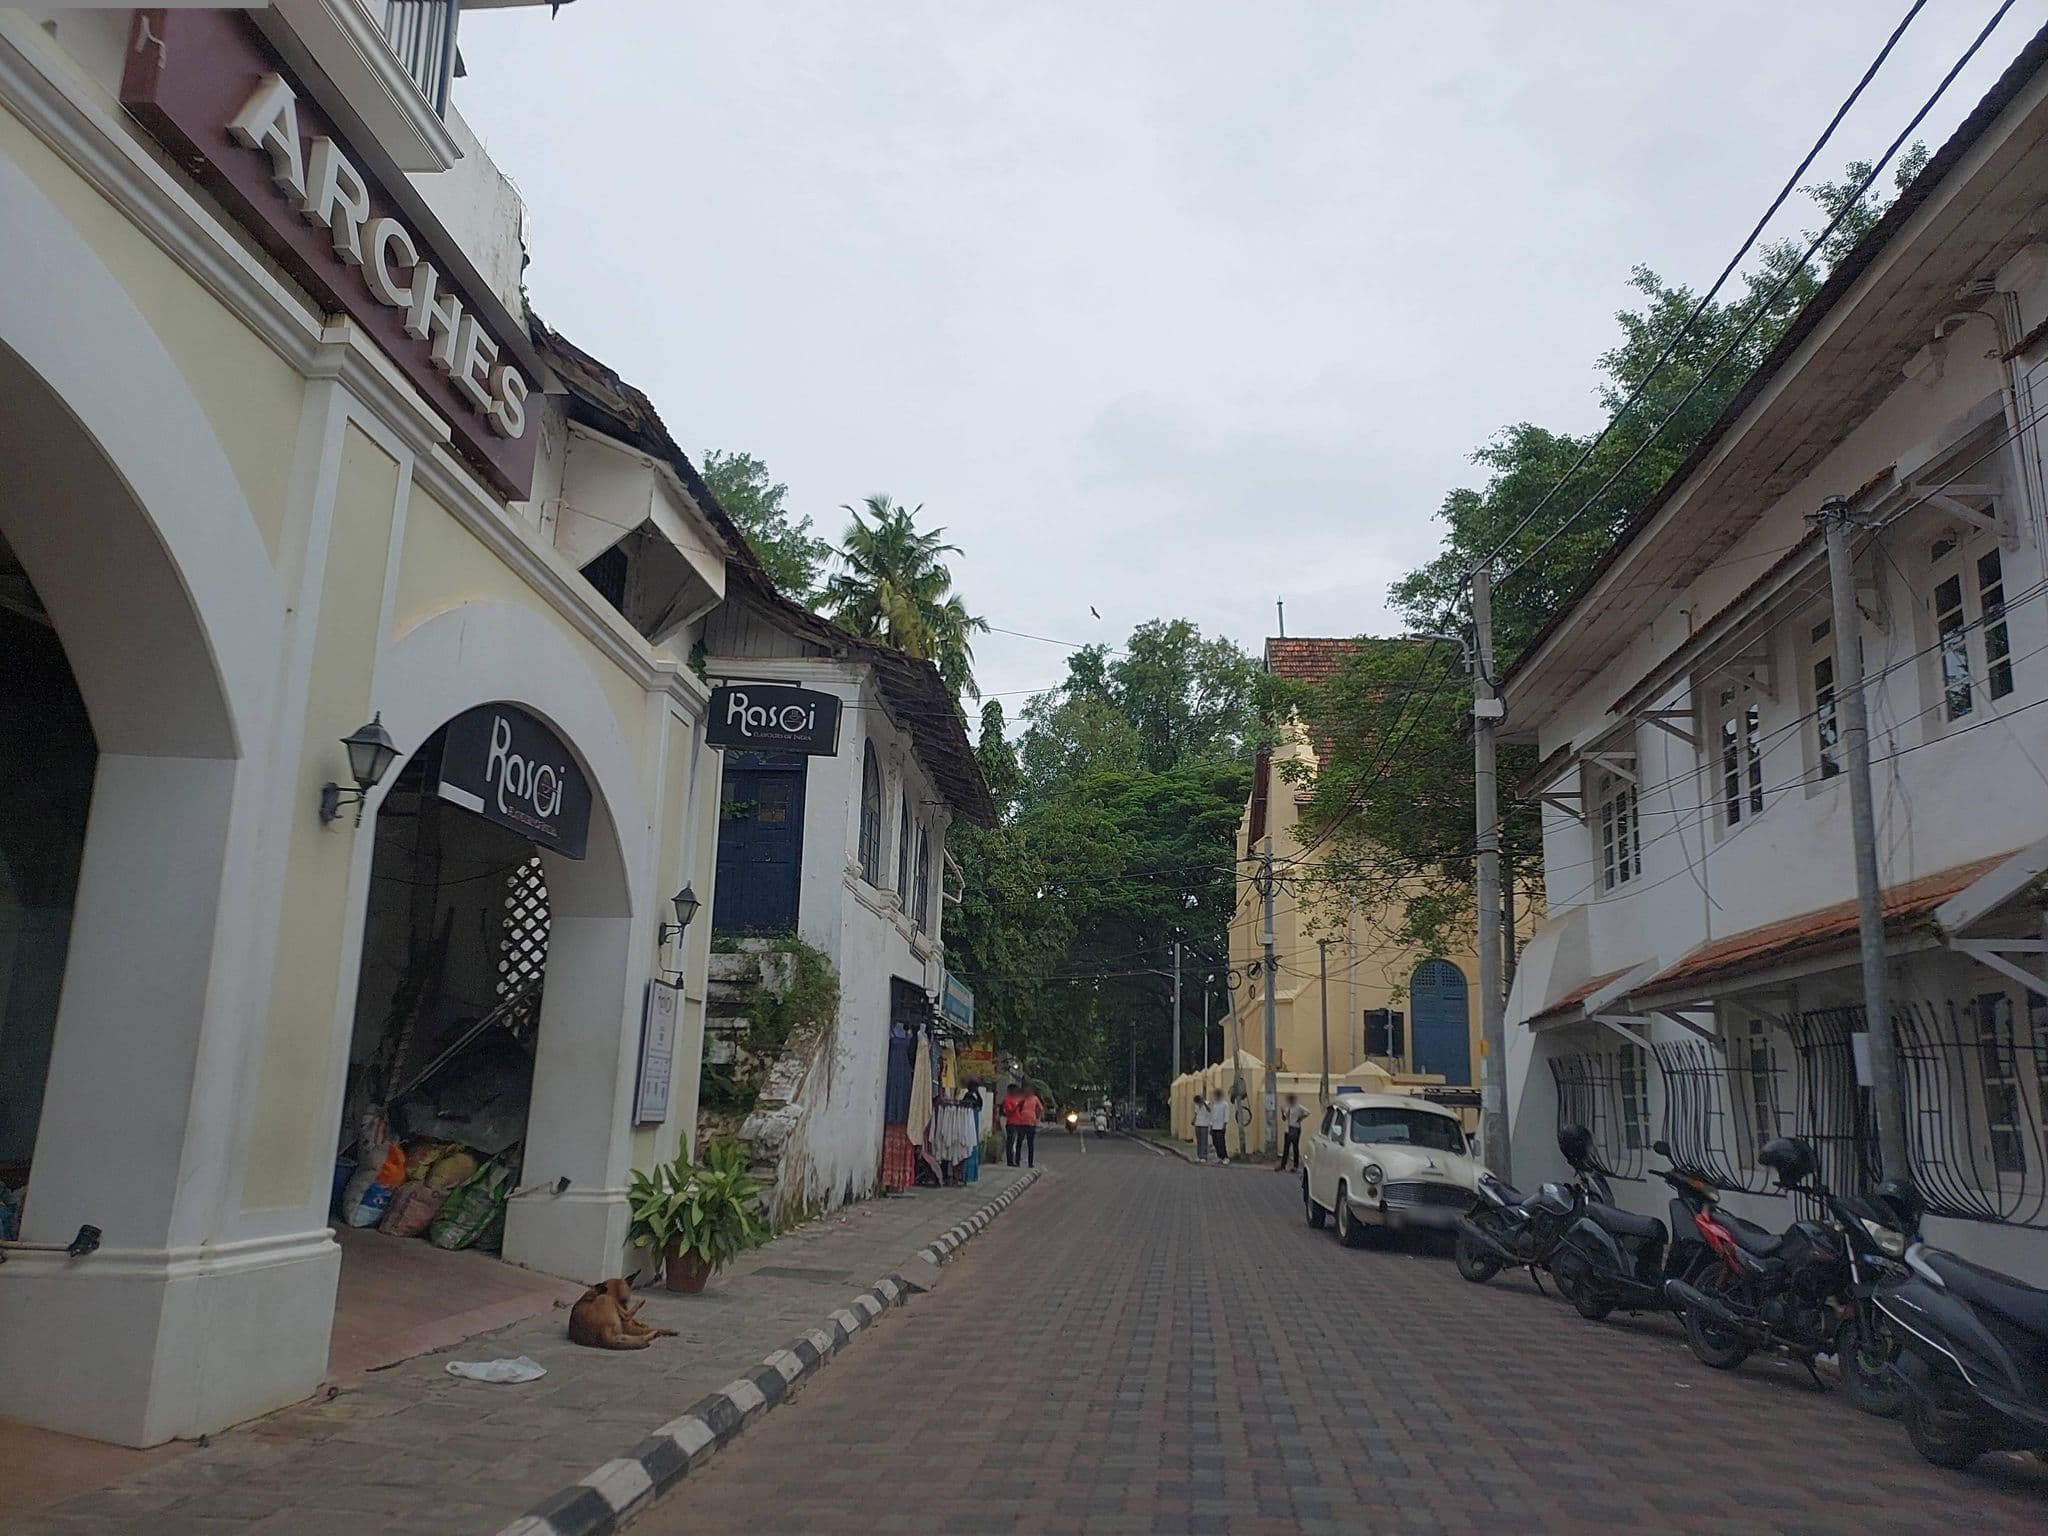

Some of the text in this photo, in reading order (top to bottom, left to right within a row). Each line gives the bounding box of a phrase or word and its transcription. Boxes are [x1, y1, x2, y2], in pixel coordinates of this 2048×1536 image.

[226, 72, 528, 439] ARCHES
[727, 692, 816, 737] Rasoi
[486, 715, 566, 818] Rasoi
